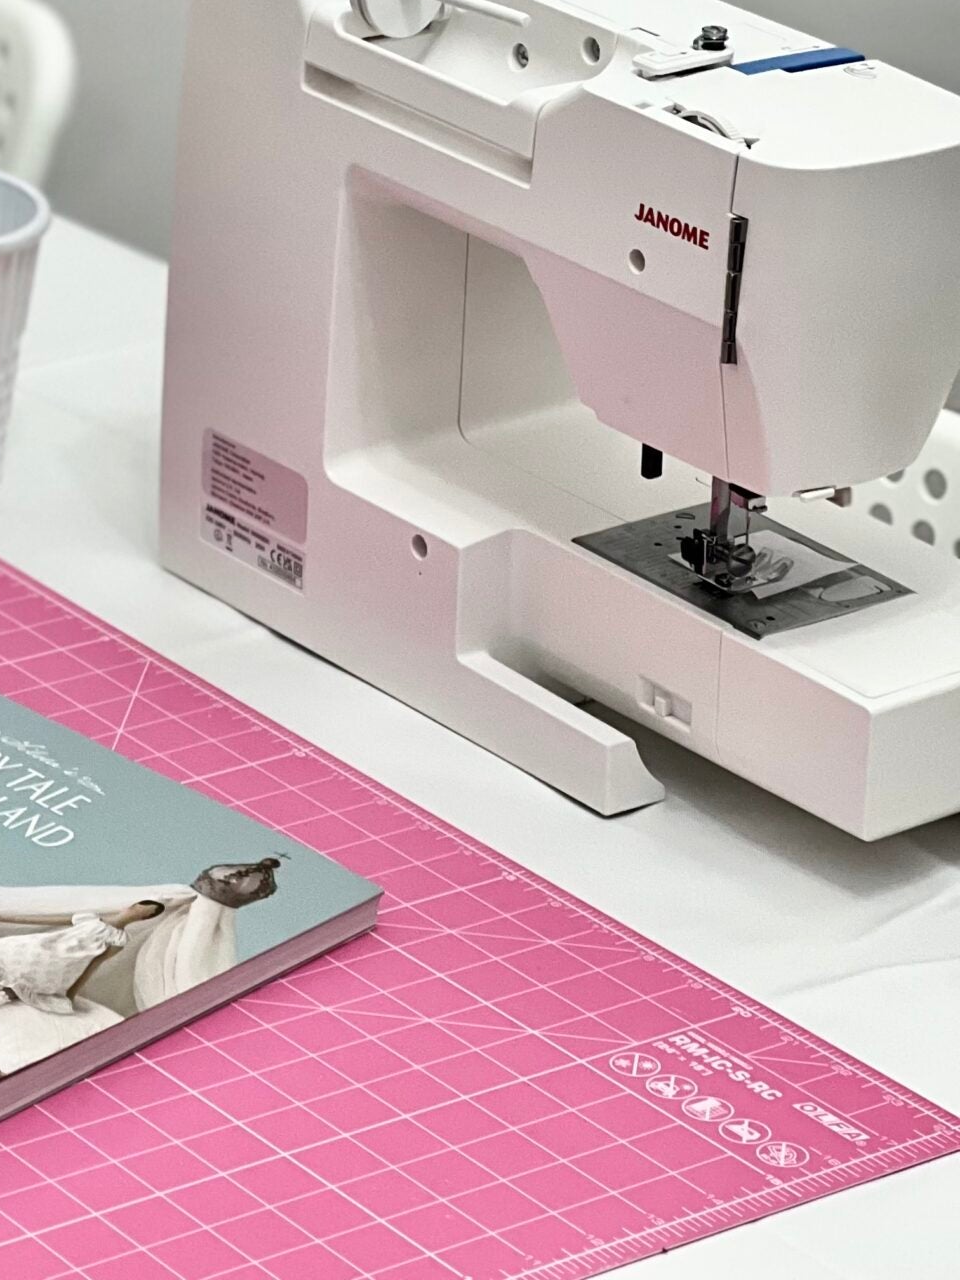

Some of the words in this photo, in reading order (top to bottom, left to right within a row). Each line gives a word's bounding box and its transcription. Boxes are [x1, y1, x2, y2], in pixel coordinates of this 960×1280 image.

[634, 203, 710, 250] JANOME
[6, 768, 91, 816] TALE
[796, 1102, 867, 1141] OLFA
